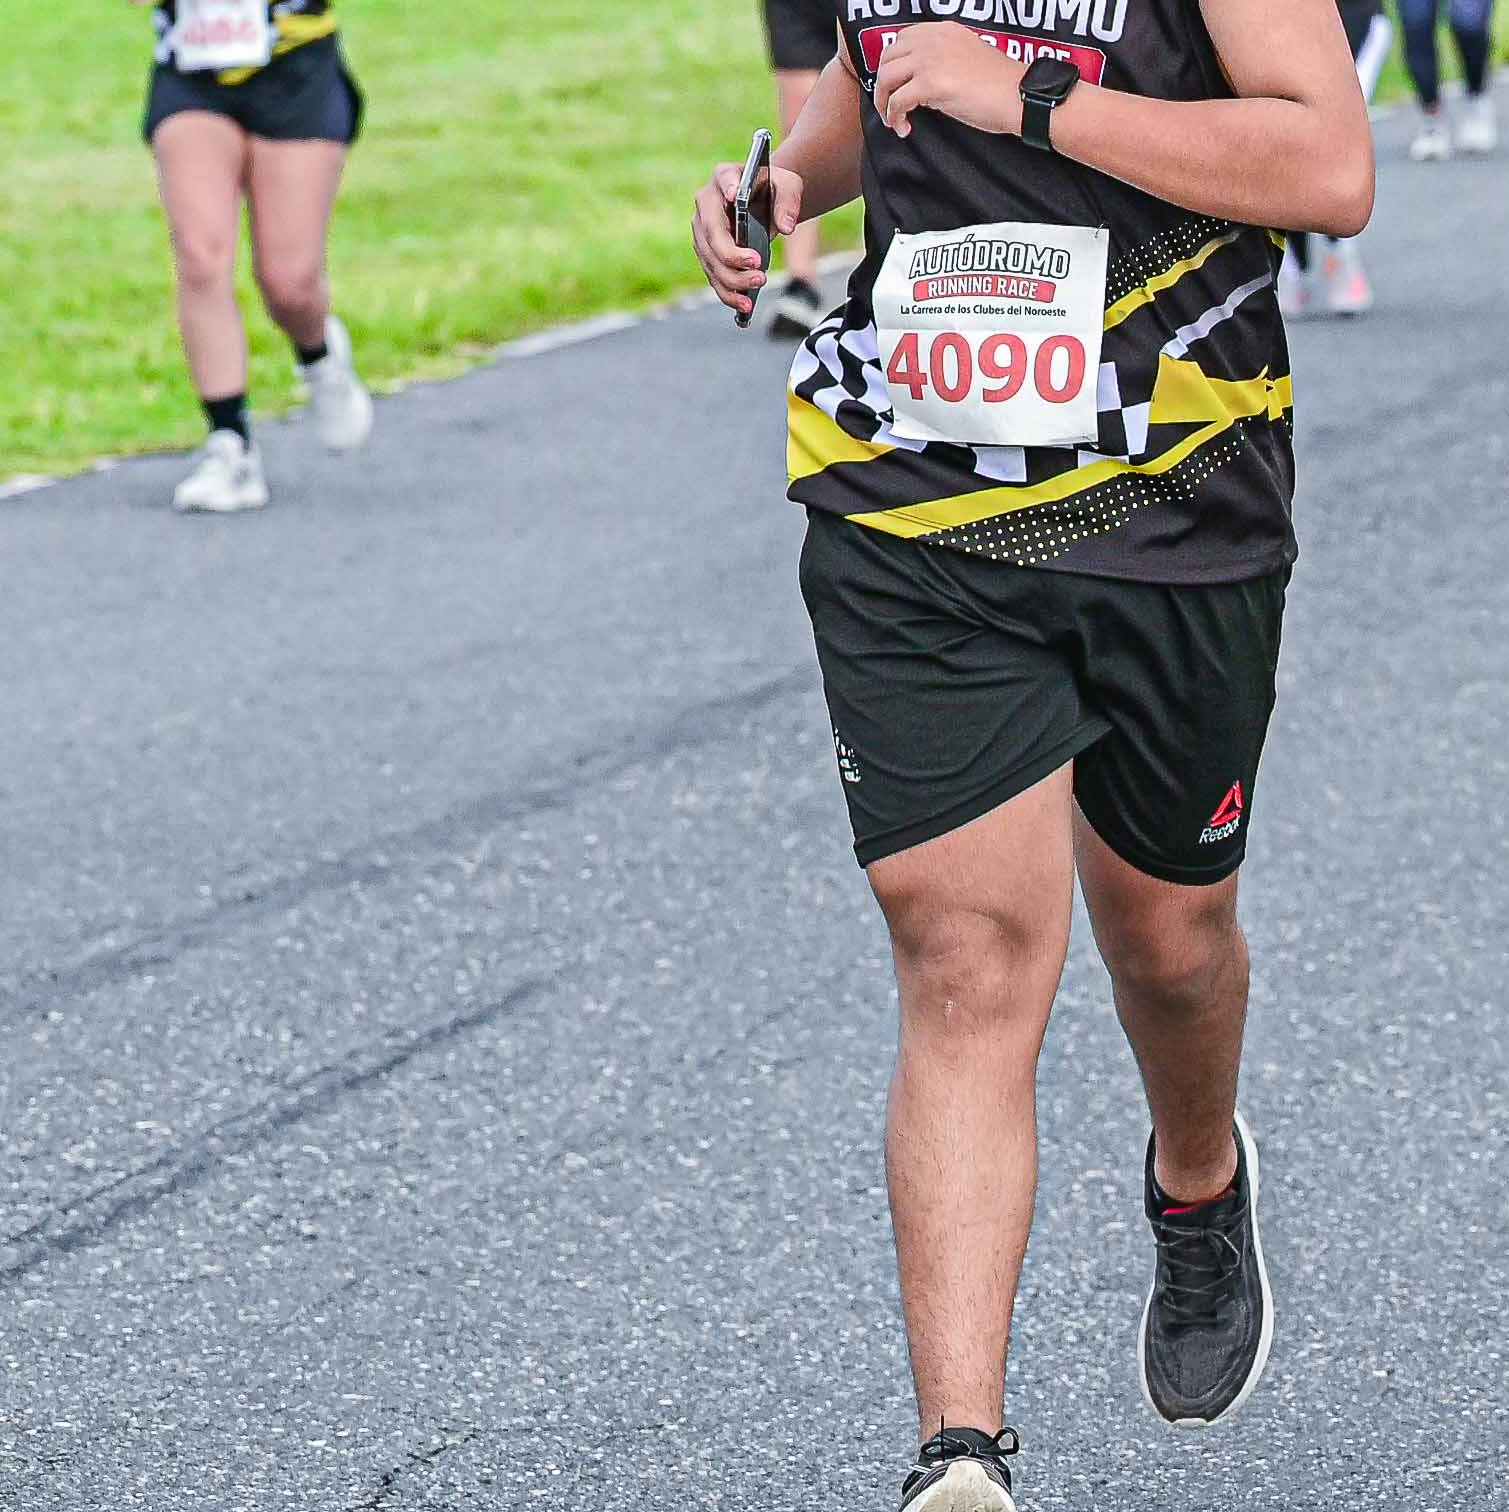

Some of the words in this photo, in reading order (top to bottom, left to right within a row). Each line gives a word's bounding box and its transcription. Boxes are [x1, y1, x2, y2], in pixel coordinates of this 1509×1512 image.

[908, 233, 1071, 280] AUTÓDROMO
[927, 276, 992, 297] RUNNING
[996, 277, 1039, 299] RACE
[900, 304, 910, 315] La
[911, 304, 943, 315] Carrera
[944, 304, 956, 314] de
[957, 303, 971, 314] los
[972, 304, 1005, 315] Clubes
[1006, 305, 1022, 316] del
[1024, 306, 1066, 317] Noroeste
[886, 332, 1086, 404] 4090
